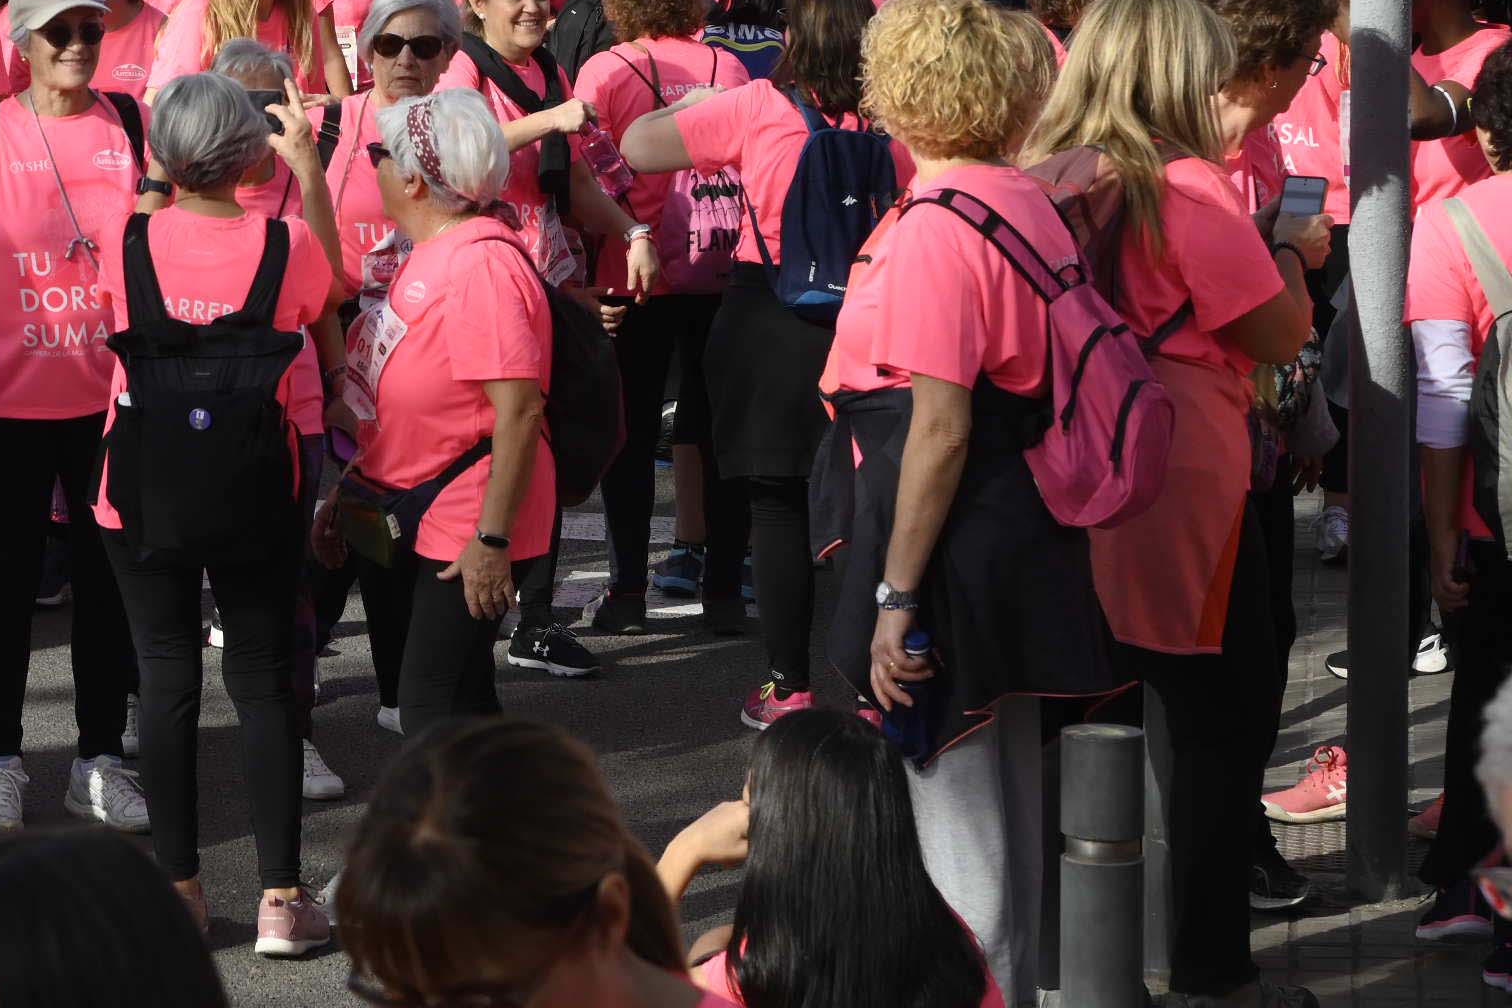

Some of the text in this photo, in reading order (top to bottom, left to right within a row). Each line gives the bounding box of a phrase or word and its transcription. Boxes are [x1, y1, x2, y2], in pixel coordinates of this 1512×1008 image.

[1267, 122, 1320, 148] RSAL
[354, 222, 388, 245] TU
[13, 250, 52, 277] TU
[19, 283, 102, 313] DORS
[163, 296, 235, 320] ARRER
[23, 319, 110, 349] SUMA
